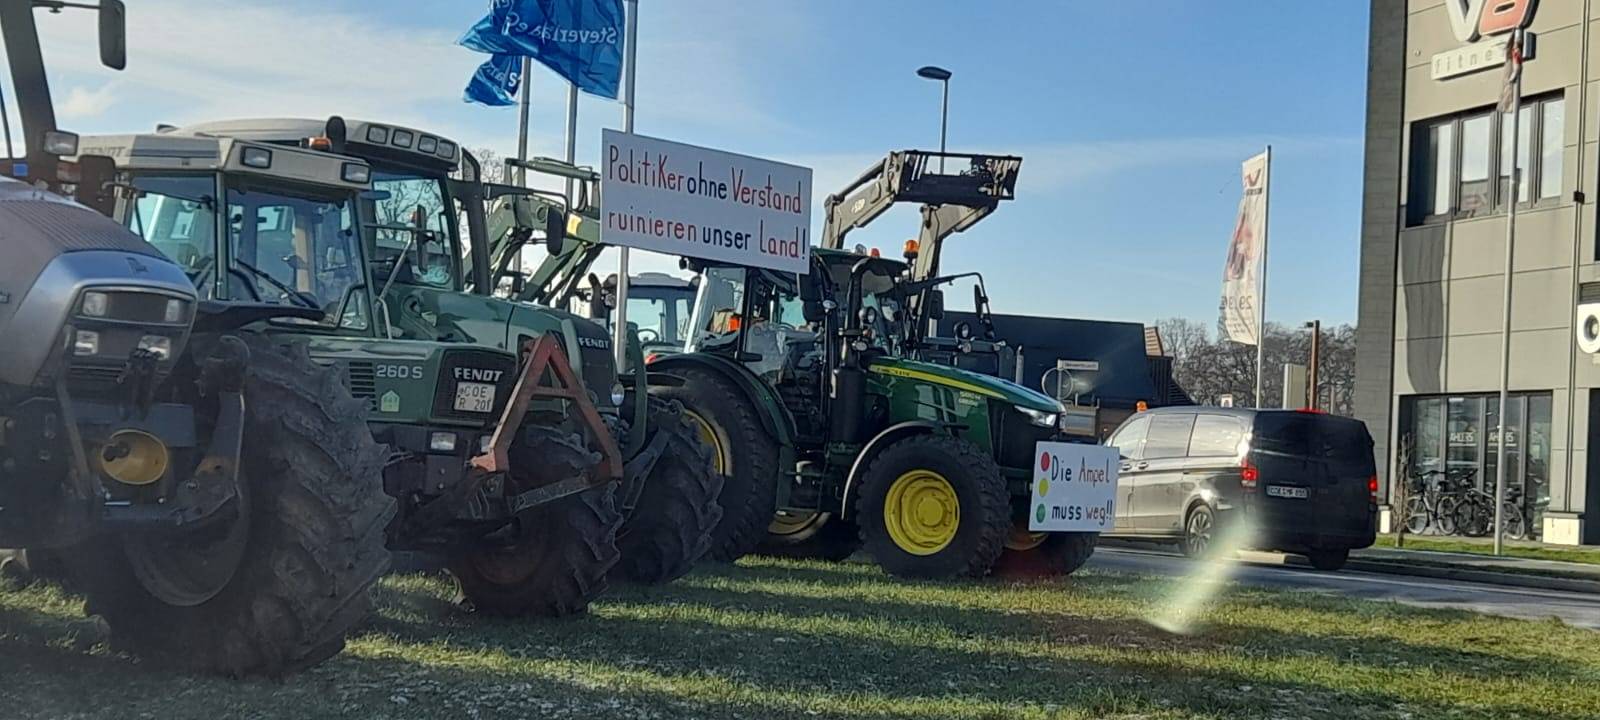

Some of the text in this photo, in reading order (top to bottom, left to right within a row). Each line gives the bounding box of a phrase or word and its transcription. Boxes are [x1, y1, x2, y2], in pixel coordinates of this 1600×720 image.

[687, 161, 727, 199] ohne
[731, 167, 802, 213] Verstand
[608, 205, 806, 260] ruinieren unser Land!
[578, 337, 609, 349] FENDT
[376, 364, 423, 379] 260 S
[454, 367, 503, 382] FENDT
[1051, 455, 1110, 488] Die Ampel
[1051, 499, 1113, 526] muss weg!!
